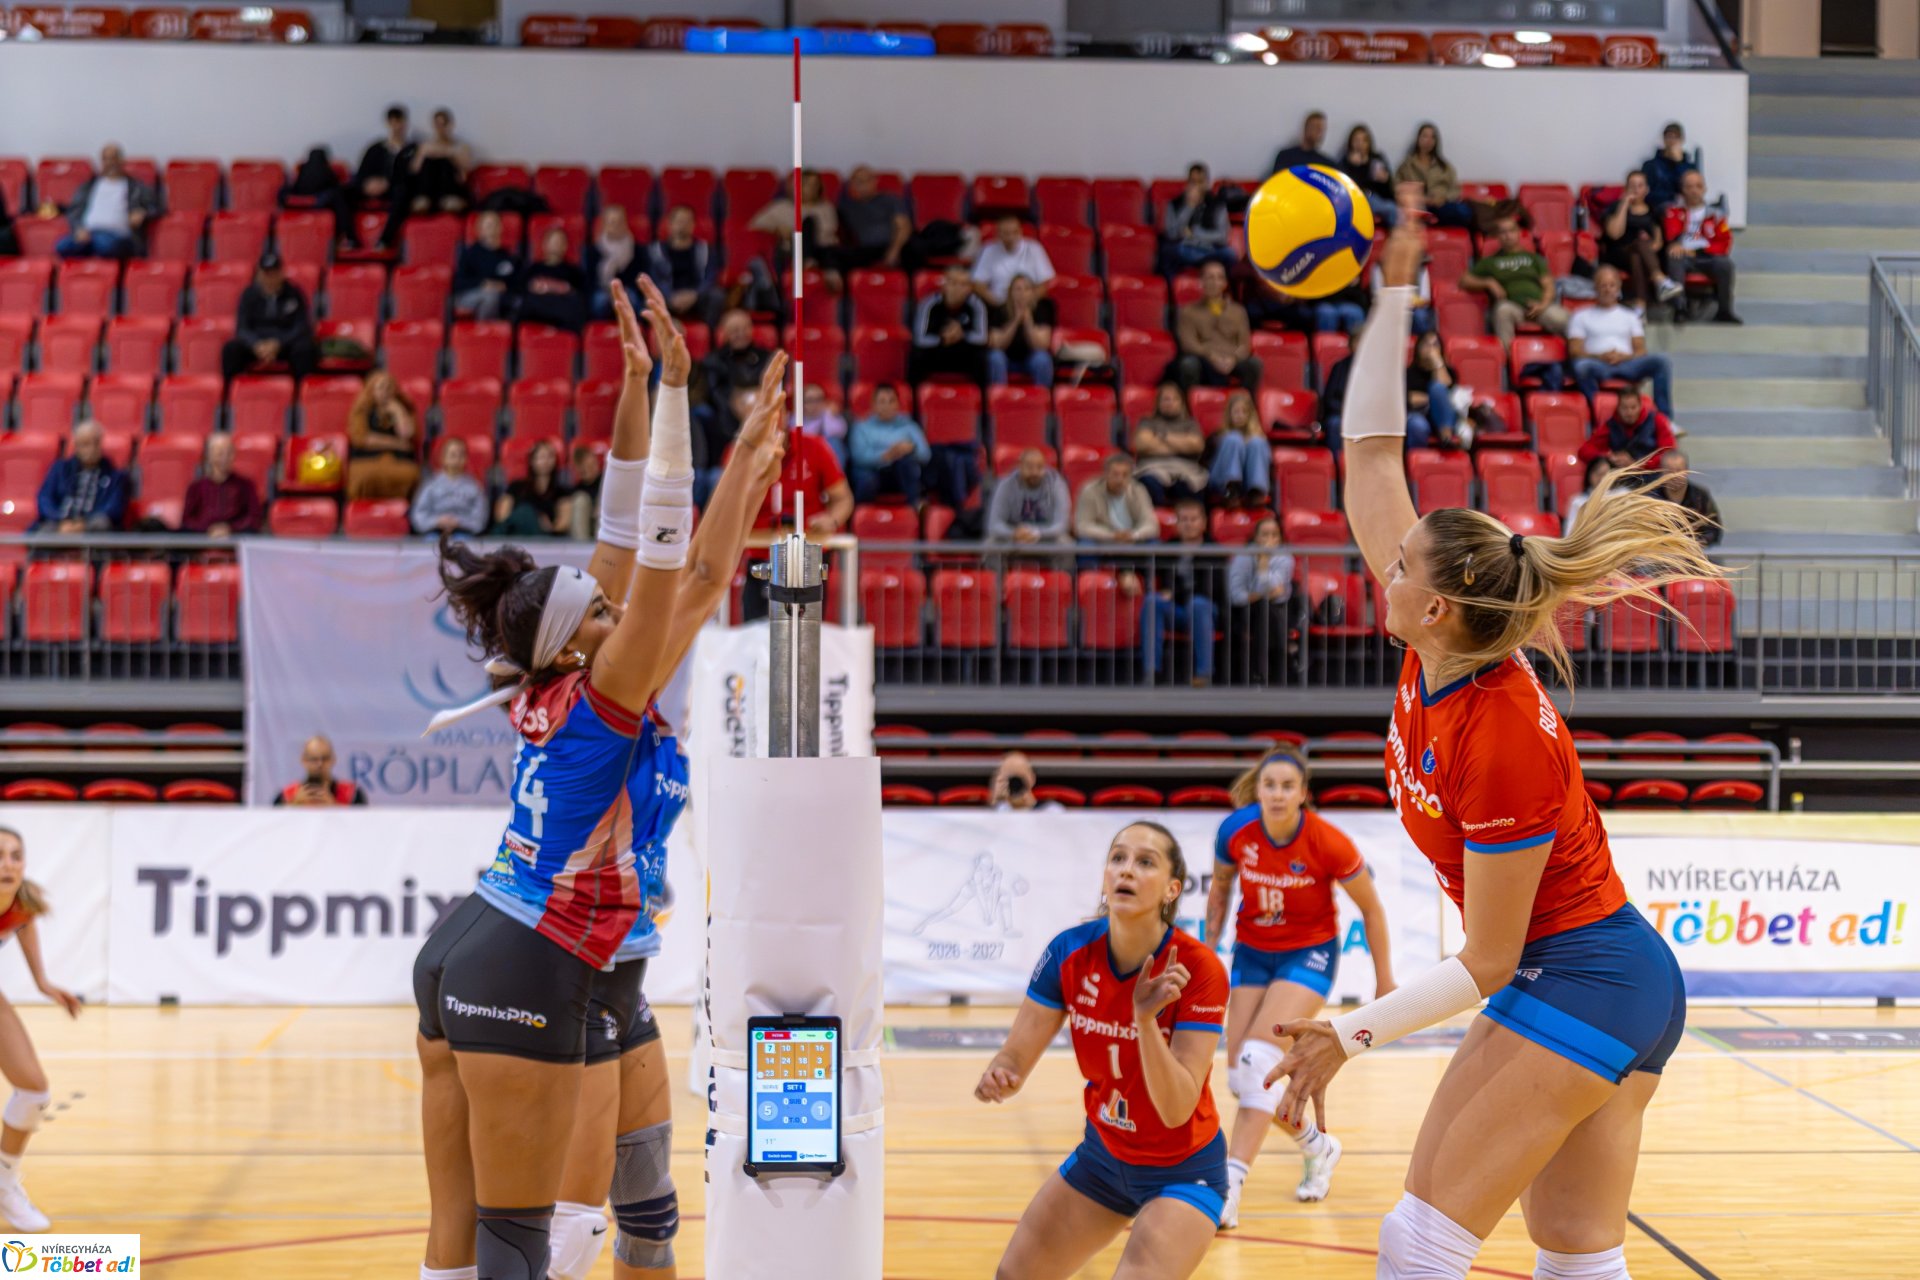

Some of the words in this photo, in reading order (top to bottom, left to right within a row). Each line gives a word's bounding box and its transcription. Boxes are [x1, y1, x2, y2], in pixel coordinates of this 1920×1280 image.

[431, 728, 513, 746] MAGYA
[1647, 864, 1842, 892] NYÍREGYHÁZA
[1258, 886, 1285, 912] 18
[1648, 900, 1817, 946] Többet
[1828, 899, 1908, 946] ad!
[972, 941, 1005, 960] 2027
[444, 996, 548, 1029] TippmixPRO
[1107, 1043, 1124, 1080] 1
[763, 1105, 773, 1117] 5
[817, 1105, 824, 1116] 1
